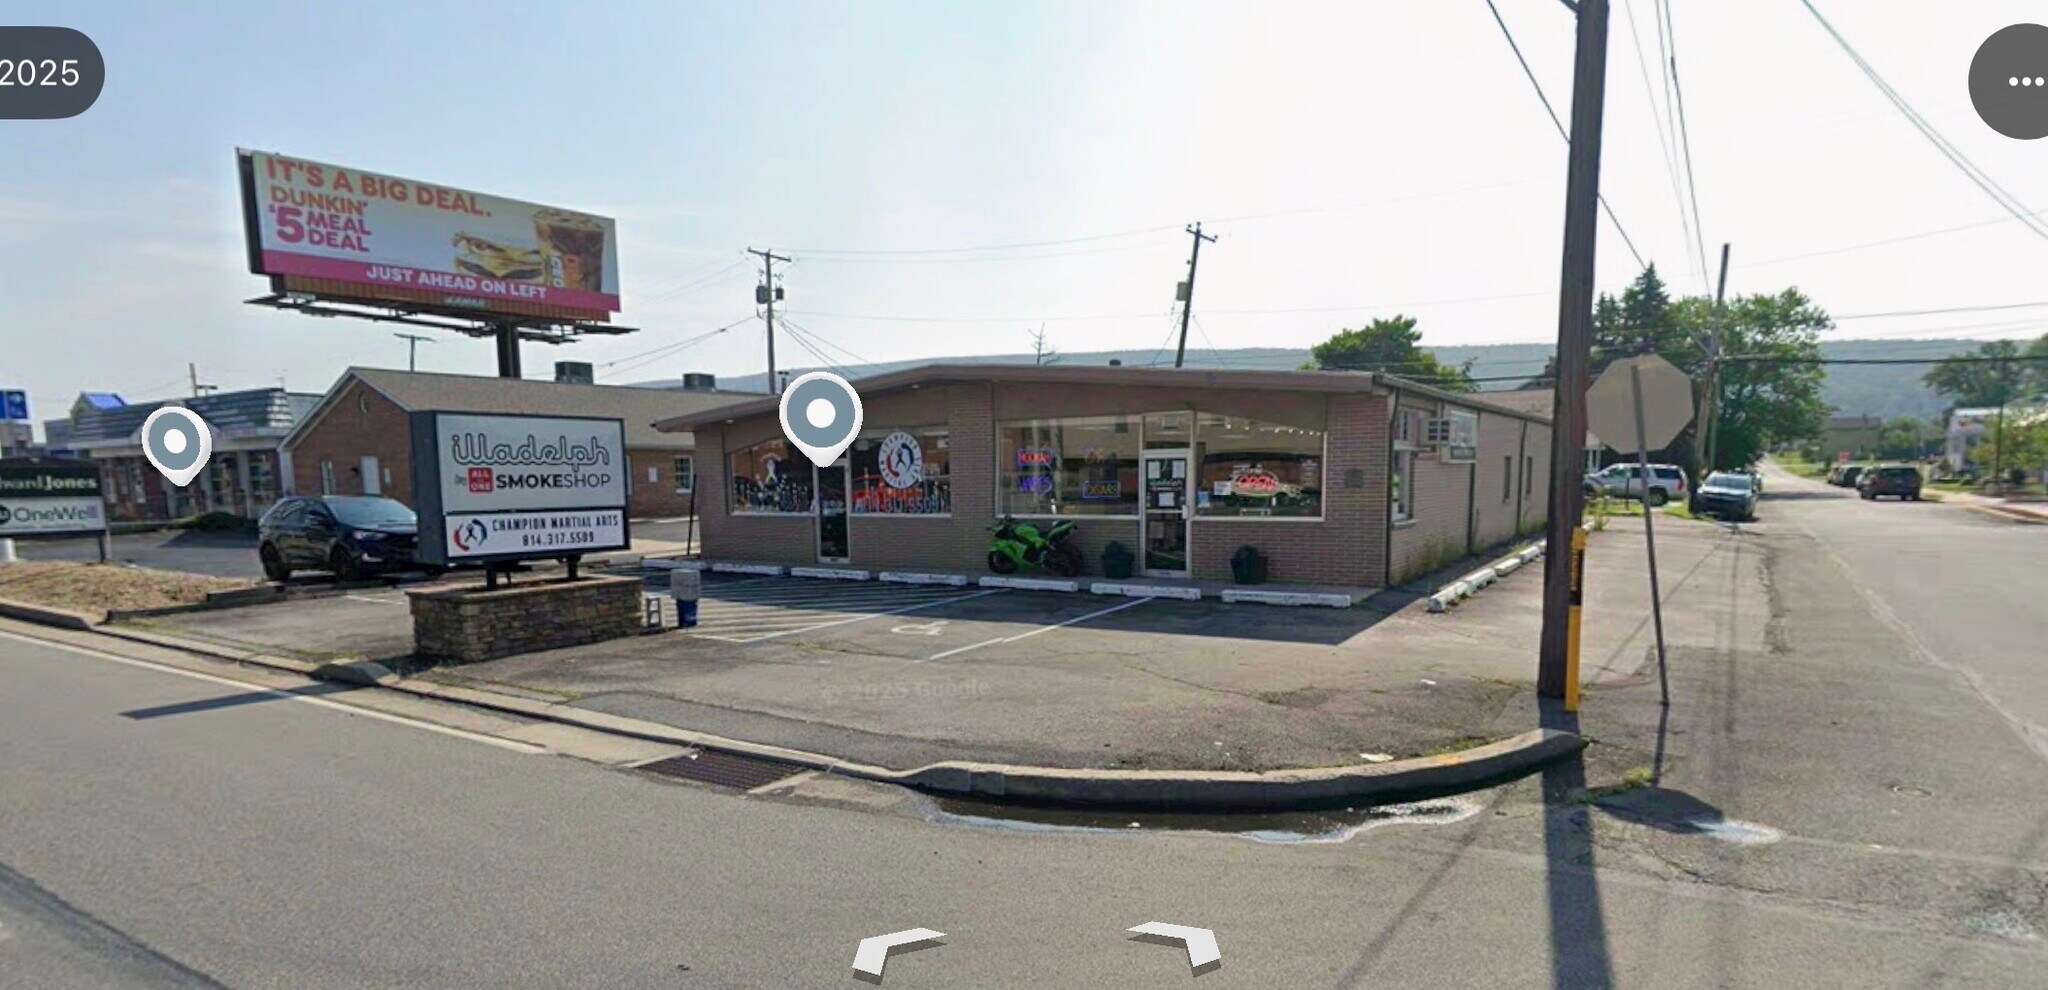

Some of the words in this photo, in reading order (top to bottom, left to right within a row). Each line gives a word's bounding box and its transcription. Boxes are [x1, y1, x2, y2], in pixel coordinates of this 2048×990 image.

[266, 156, 325, 188] IT'S
[333, 171, 353, 194] A
[359, 174, 408, 202] BIG
[415, 185, 492, 218] DEAL.
[270, 185, 369, 216] DUNKIN'
[307, 211, 372, 236] MEAL
[308, 228, 370, 253] DEAL
[366, 265, 414, 283] JUST
[418, 271, 477, 291] AHEAD
[481, 279, 506, 295] ON
[511, 284, 547, 300] LEFT
[452, 433, 610, 473] illadelph
[496, 473, 611, 489] SMOKESHOP
[1235, 475, 1276, 491] OPEN
[14, 505, 98, 522] OneWe
[492, 518, 546, 531] CHAMPION
[551, 516, 591, 529] MARTIAL
[596, 514, 618, 527] ARTS
